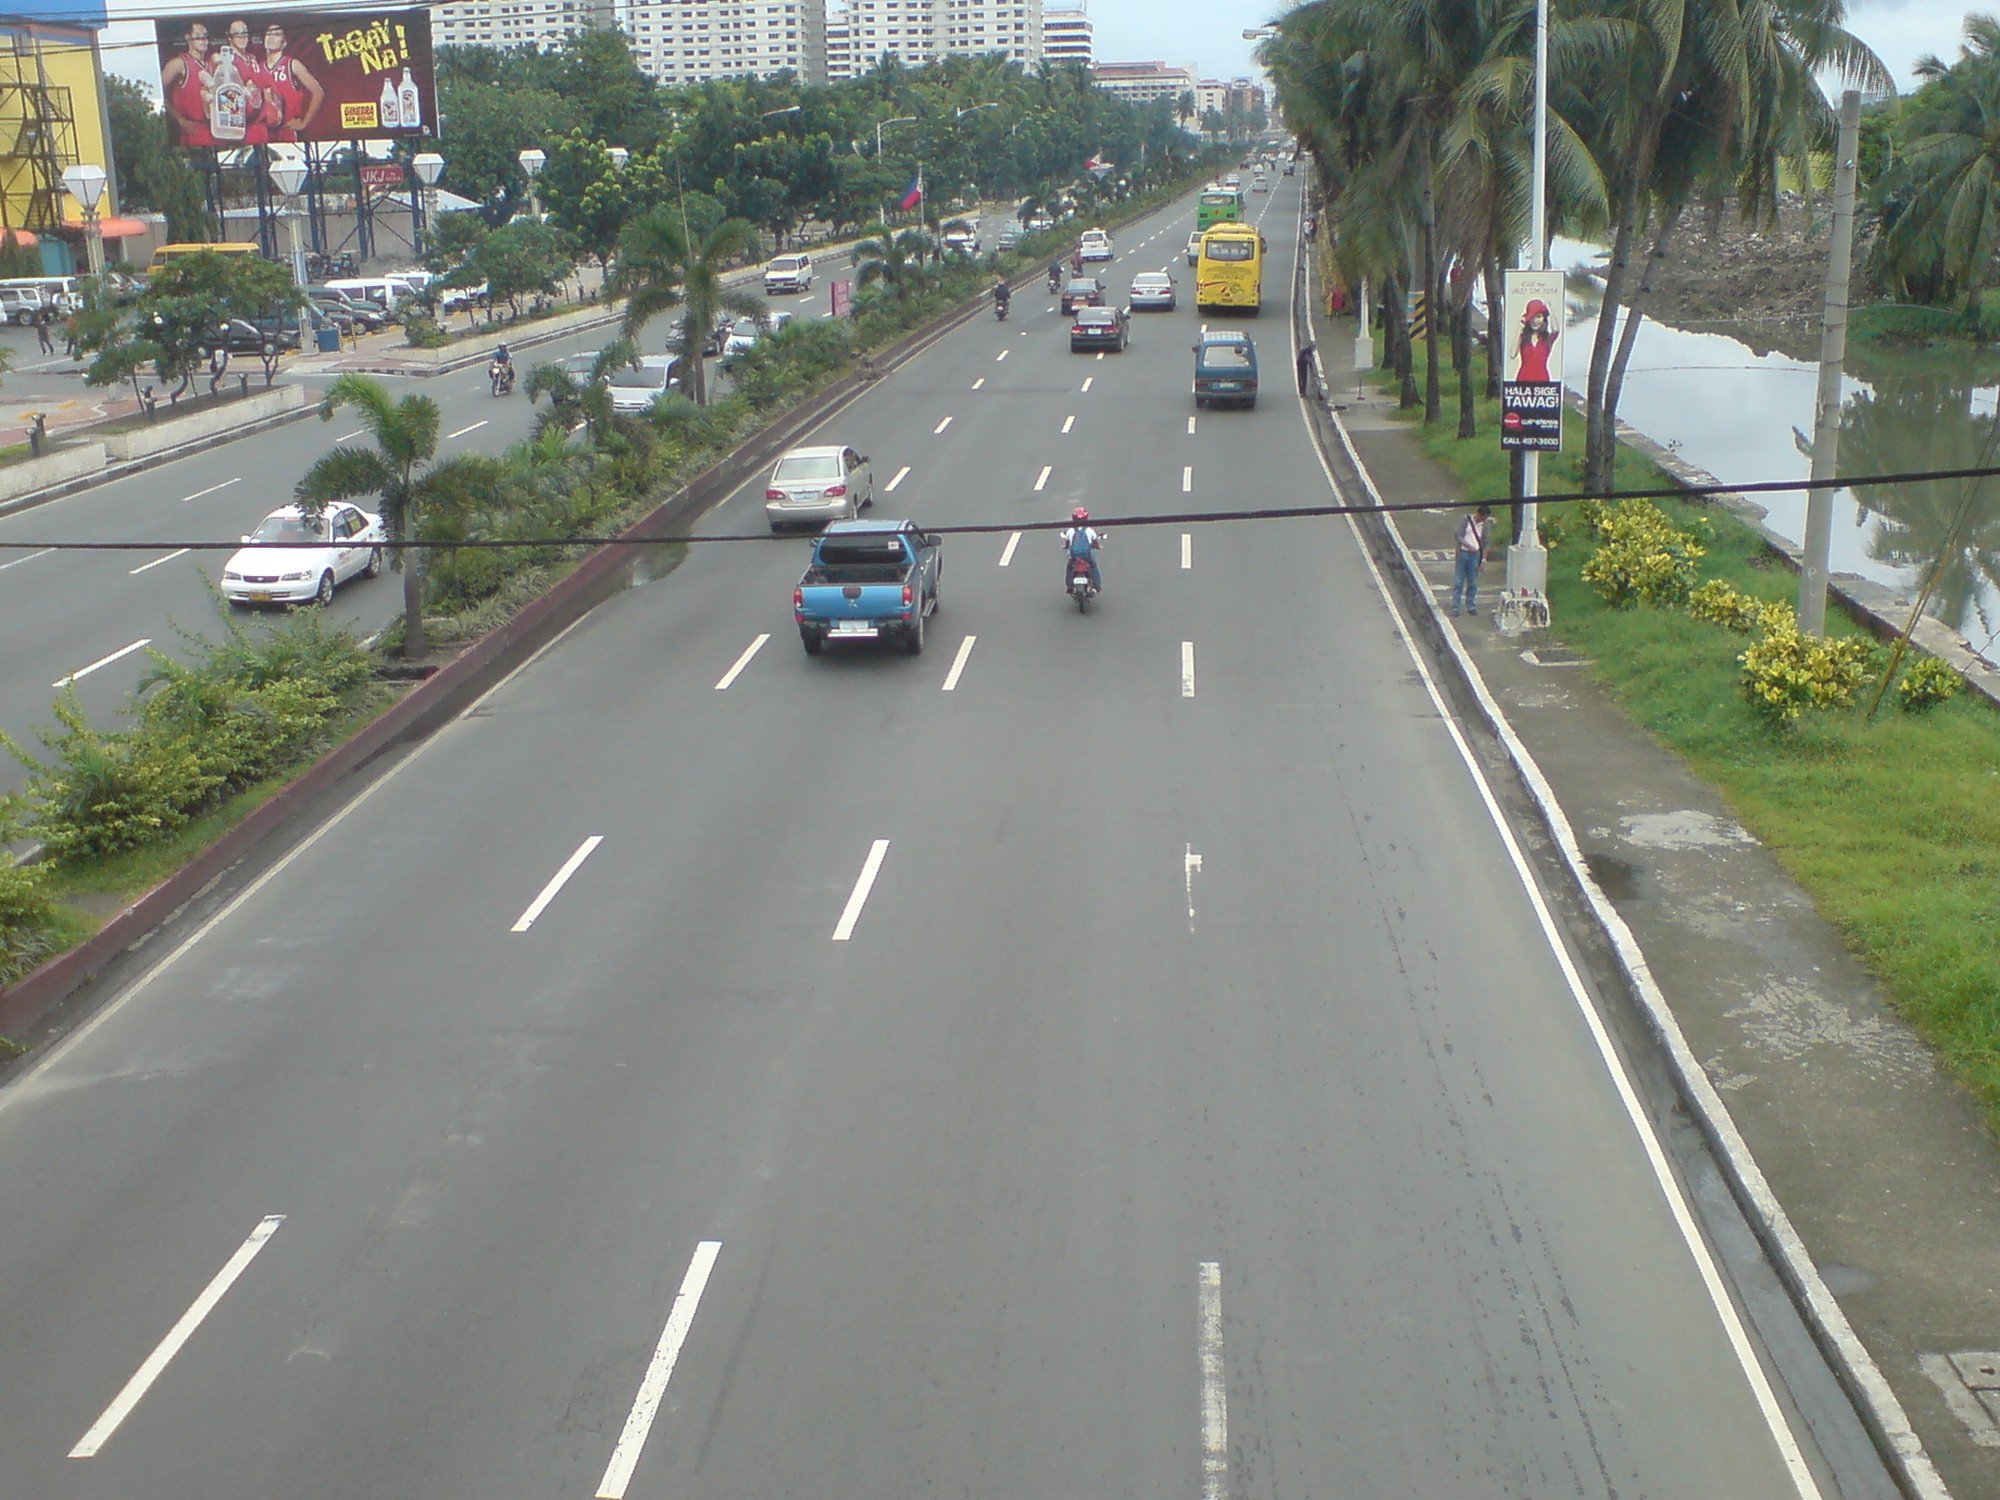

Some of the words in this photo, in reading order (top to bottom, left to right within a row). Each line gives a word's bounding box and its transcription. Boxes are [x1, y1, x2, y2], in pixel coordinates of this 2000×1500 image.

[363, 170, 385, 183] JKJ
[1504, 386, 1532, 396] HALA
[1504, 396, 1559, 408] TAWAG!
[1503, 437, 1521, 445] CALL
